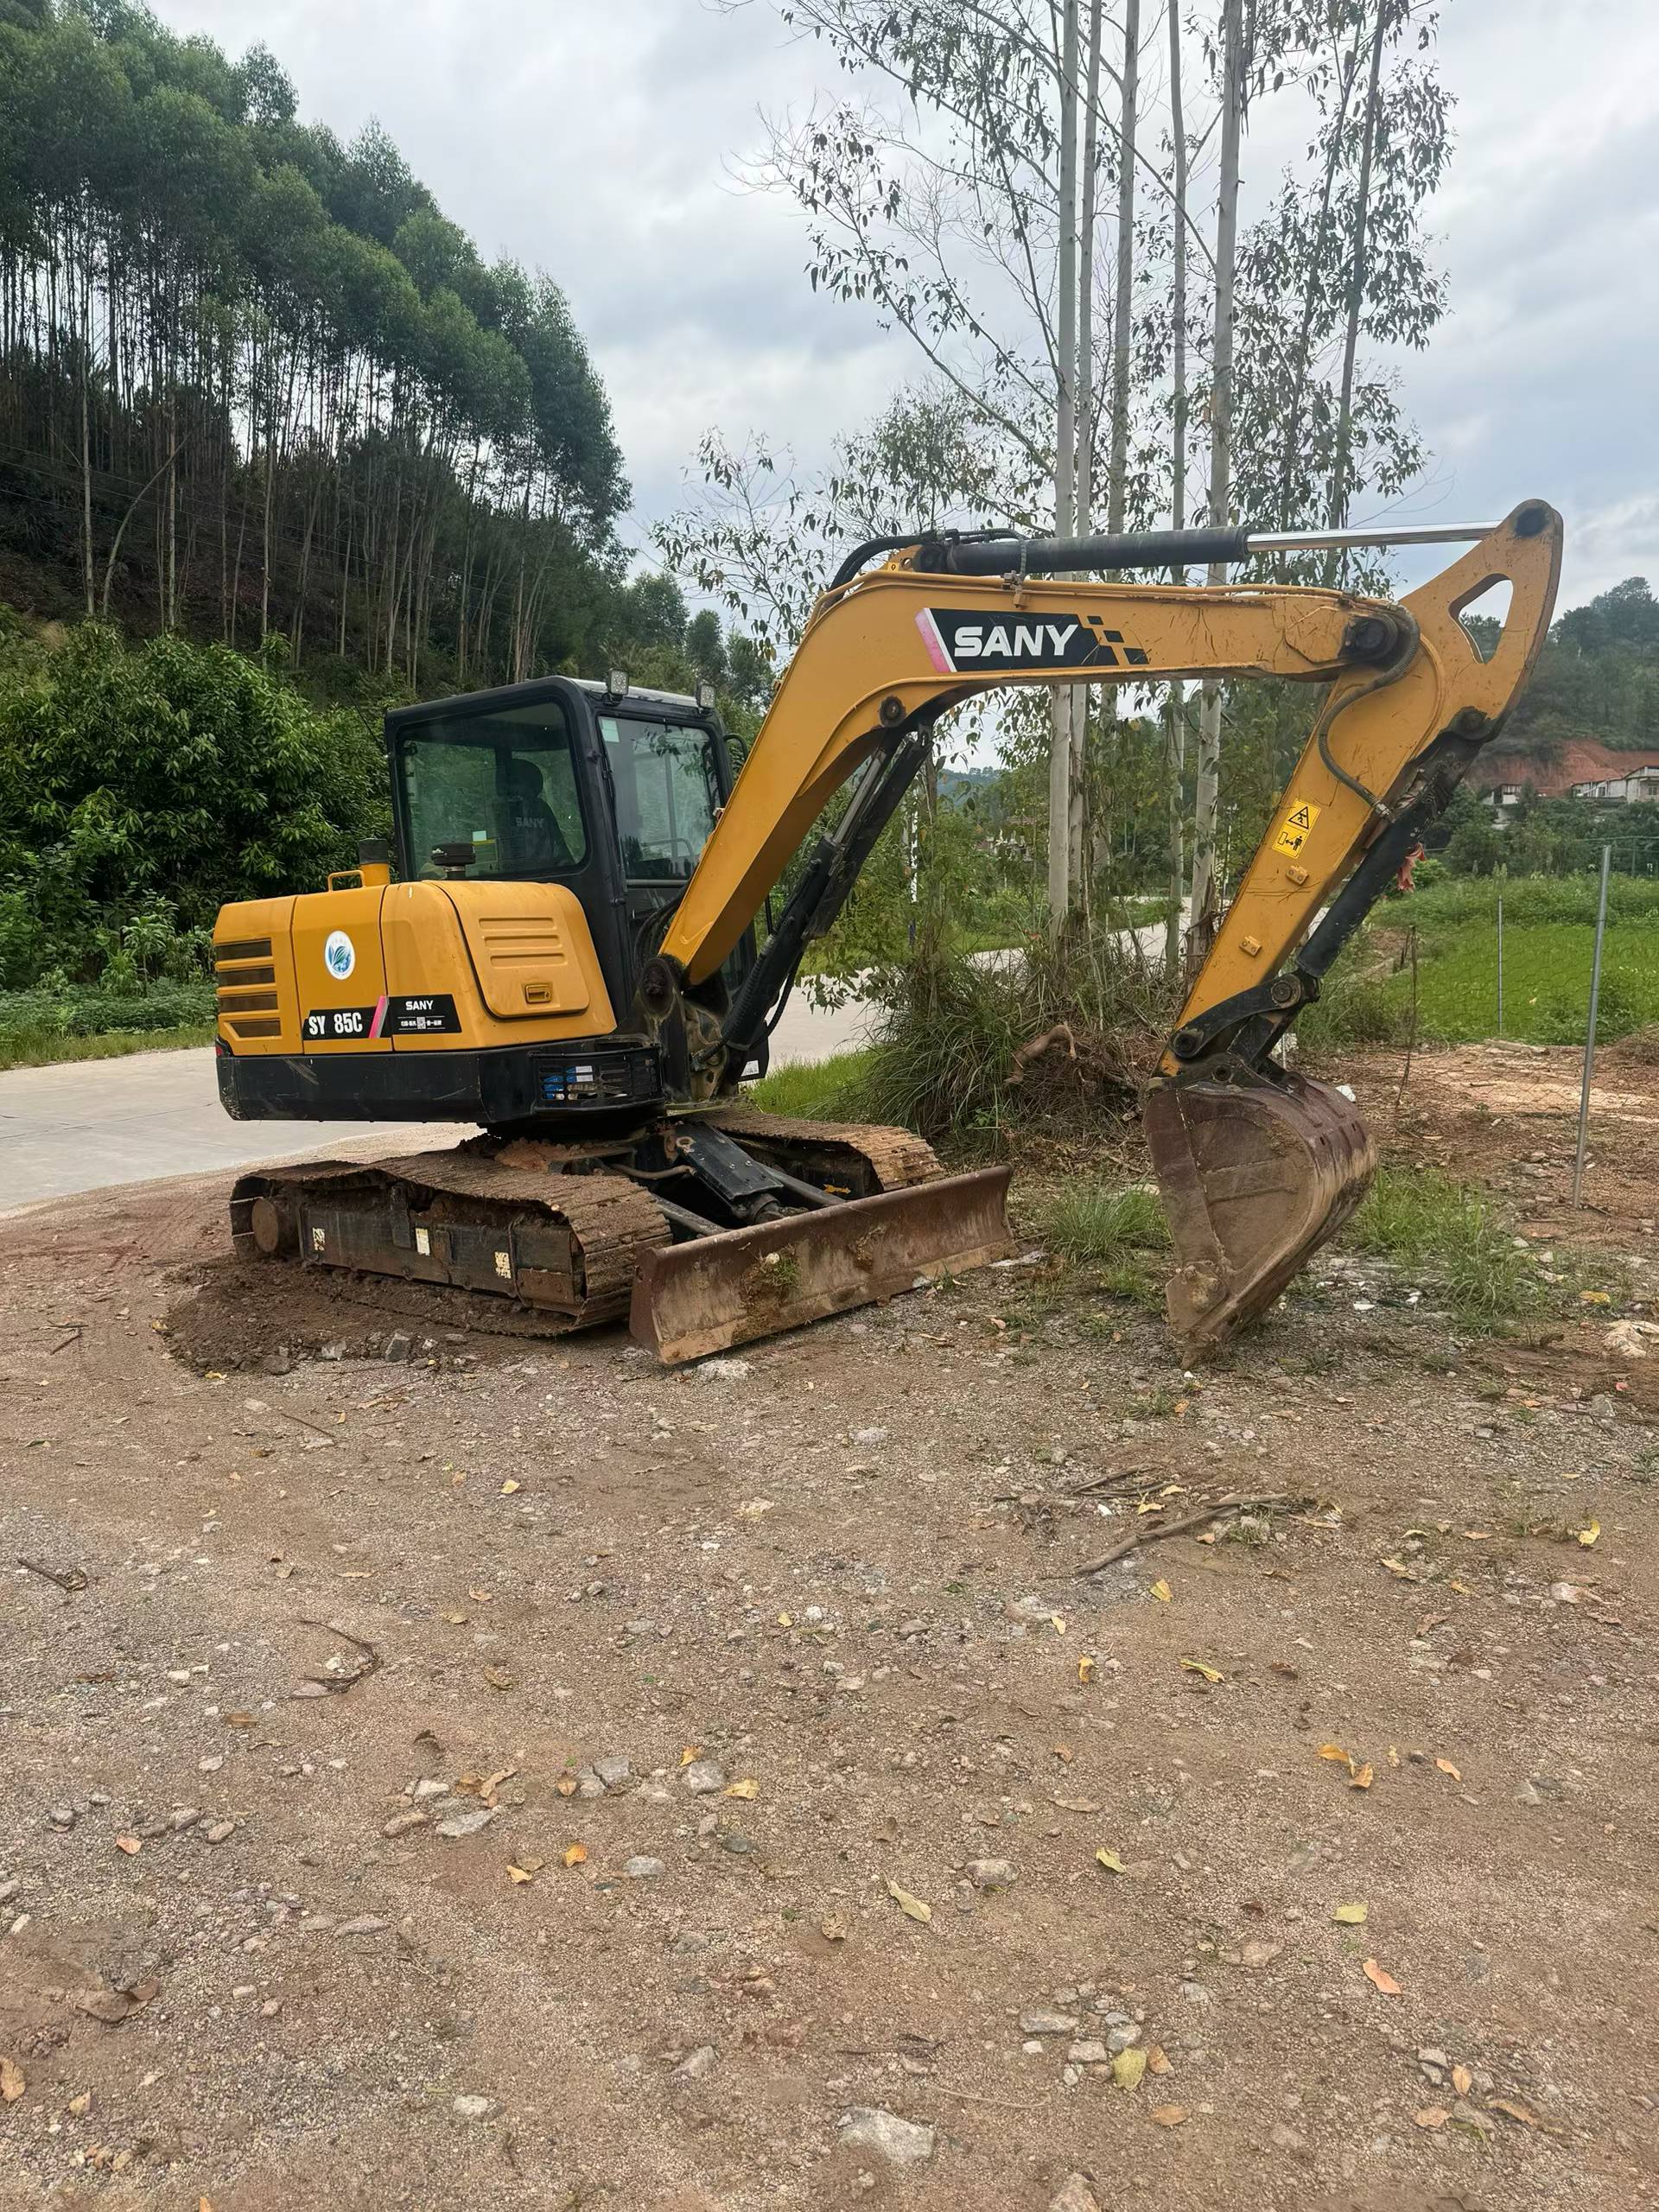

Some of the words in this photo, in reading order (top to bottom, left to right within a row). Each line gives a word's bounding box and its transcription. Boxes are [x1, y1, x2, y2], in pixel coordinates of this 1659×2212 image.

[954, 624, 1078, 658] SANY
[516, 817, 544, 828] SANY
[405, 1000, 434, 1011] SANY
[308, 1015, 326, 1035] SY
[334, 1012, 363, 1034] 85C
